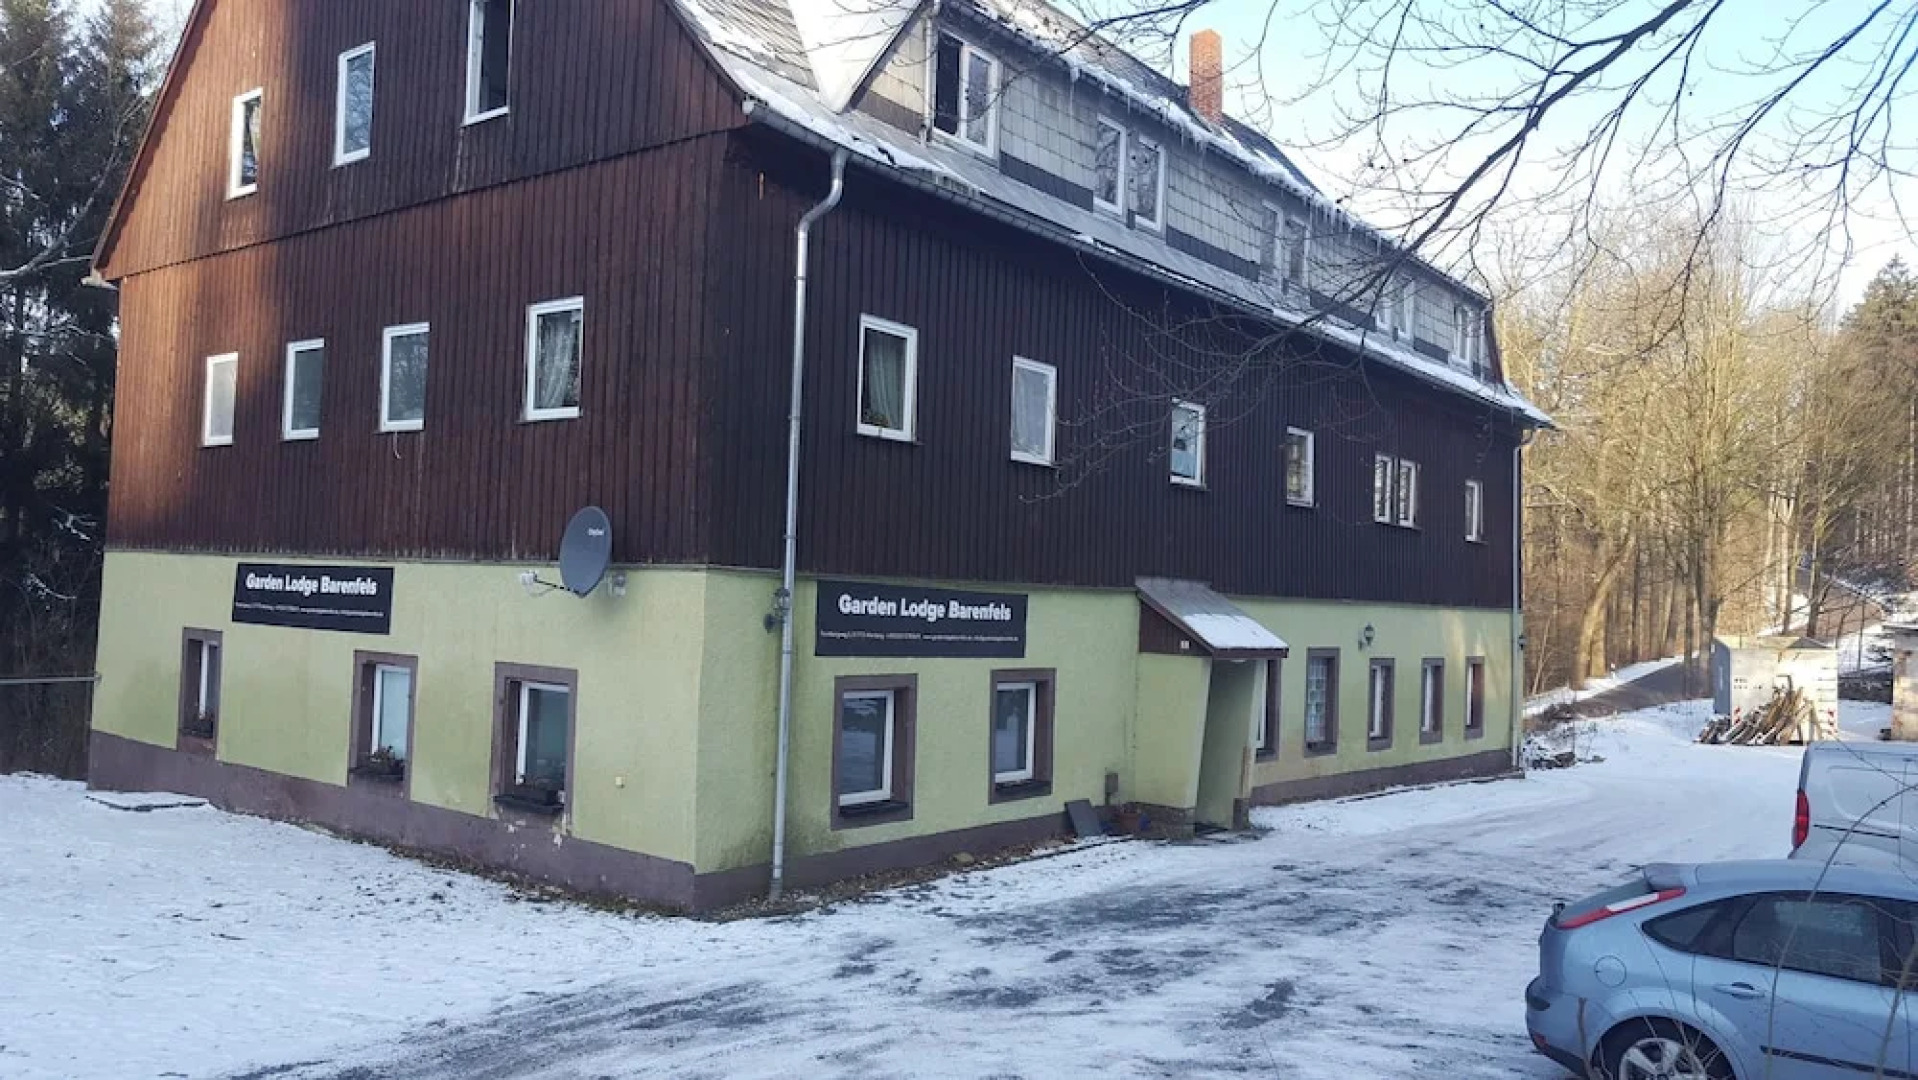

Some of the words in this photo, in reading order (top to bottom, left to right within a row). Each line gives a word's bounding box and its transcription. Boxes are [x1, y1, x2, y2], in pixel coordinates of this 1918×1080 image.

[246, 572, 283, 590] Garden
[285, 574, 318, 596] Lodge
[321, 575, 377, 595] Barenfels
[839, 594, 896, 616] Garden
[900, 598, 945, 622] Lodge
[948, 600, 1011, 621] Barenfels
